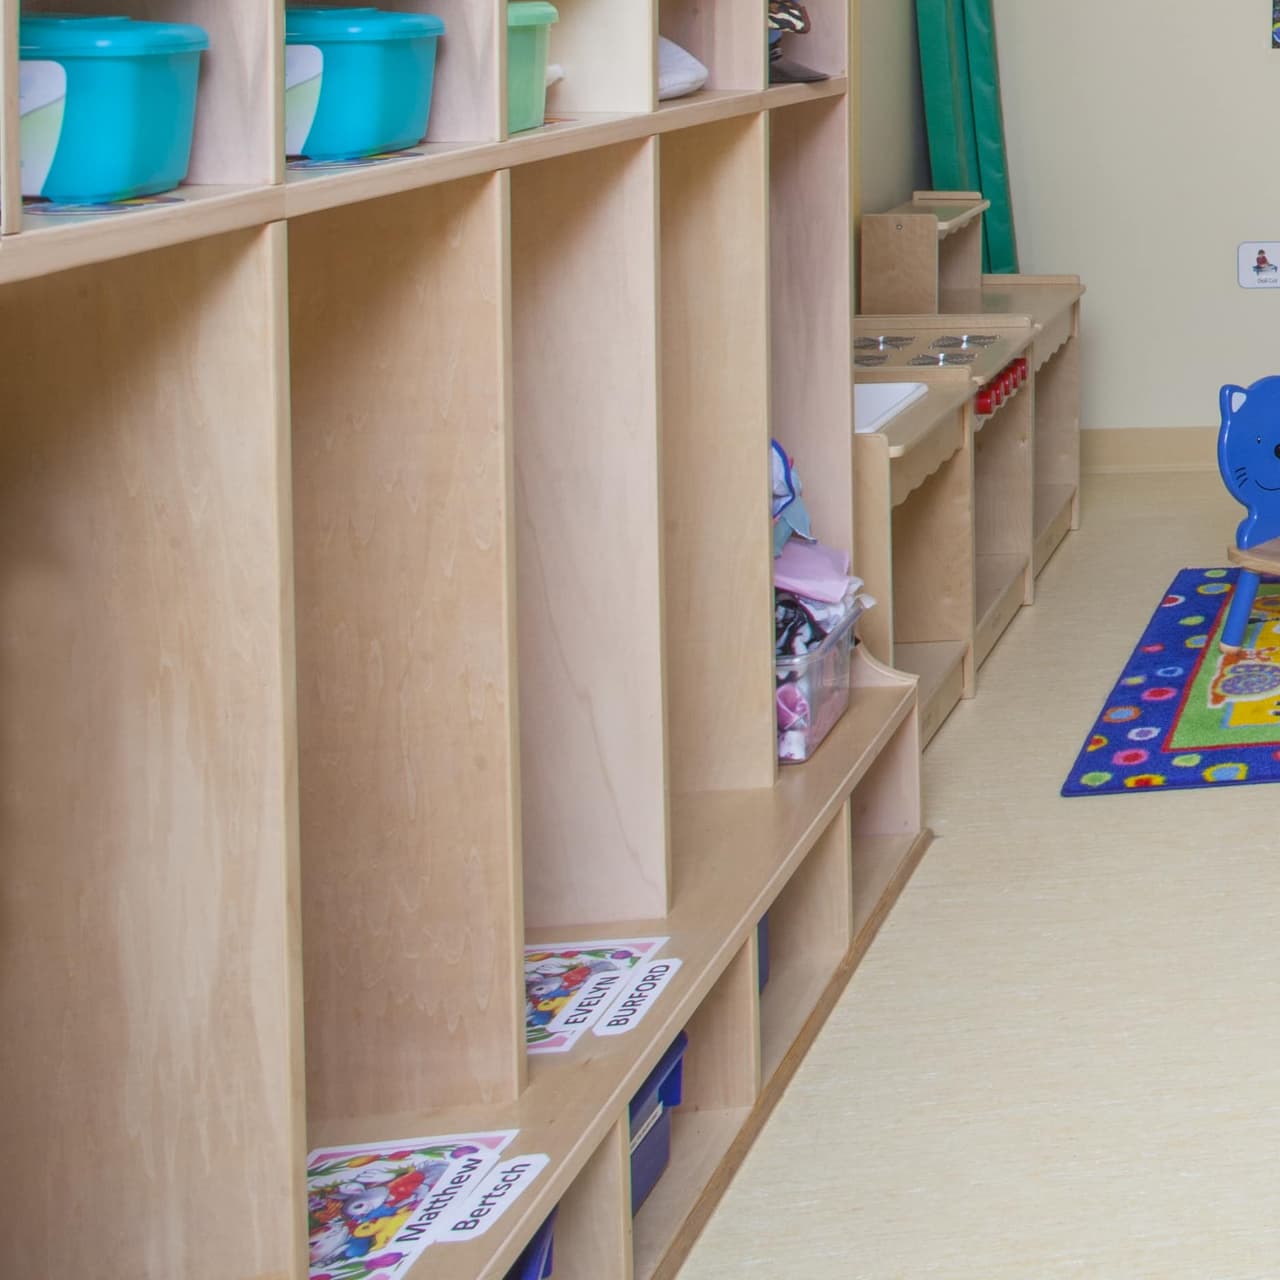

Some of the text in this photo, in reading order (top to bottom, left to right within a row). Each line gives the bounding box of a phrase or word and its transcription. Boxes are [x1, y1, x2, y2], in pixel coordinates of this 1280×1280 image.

[564, 974, 620, 1026] EVELYN
[606, 963, 671, 1028] BURFORD
[395, 1158, 483, 1243] Matthew
[451, 1163, 531, 1232] Bertsch
